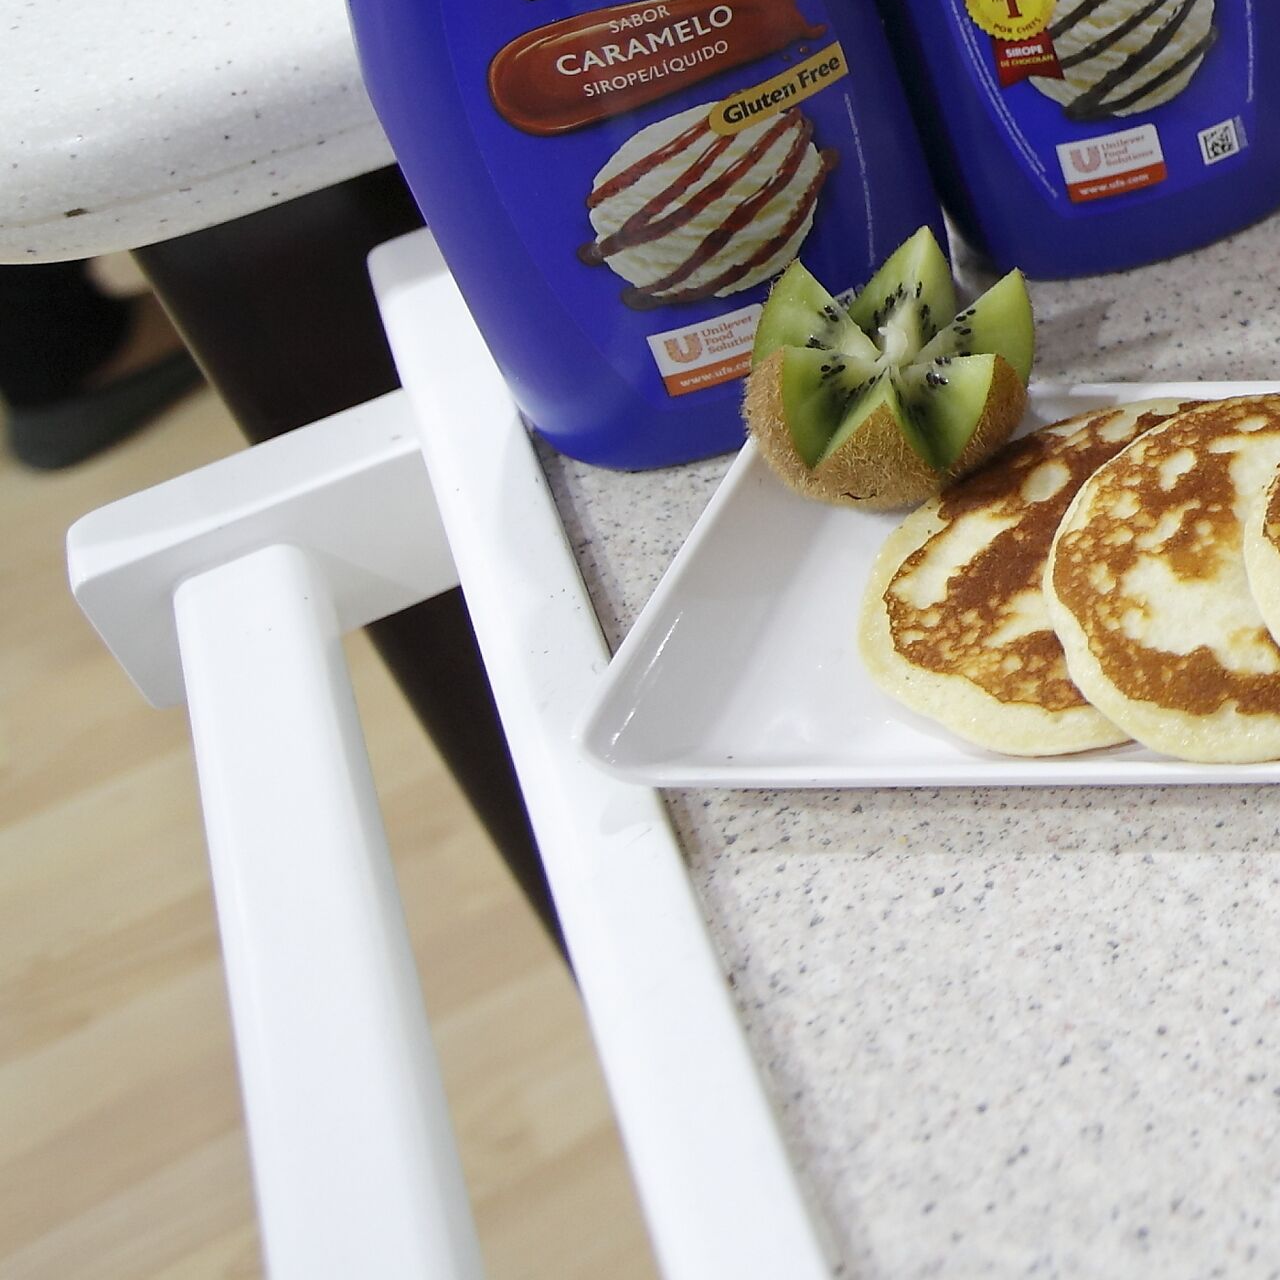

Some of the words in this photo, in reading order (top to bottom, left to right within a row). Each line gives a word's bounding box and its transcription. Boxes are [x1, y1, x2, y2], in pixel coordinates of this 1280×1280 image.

[608, 4, 670, 35] SABOR
[993, 22, 1012, 34] POR
[556, 5, 733, 76] CARAMELO
[1005, 43, 1044, 58] SIROPE
[583, 39, 729, 98] SIROPE/LÍQUIDO
[722, 81, 797, 124] Gluten
[799, 54, 841, 89] Free
[701, 315, 752, 338] Unilever
[704, 330, 734, 346] Food
